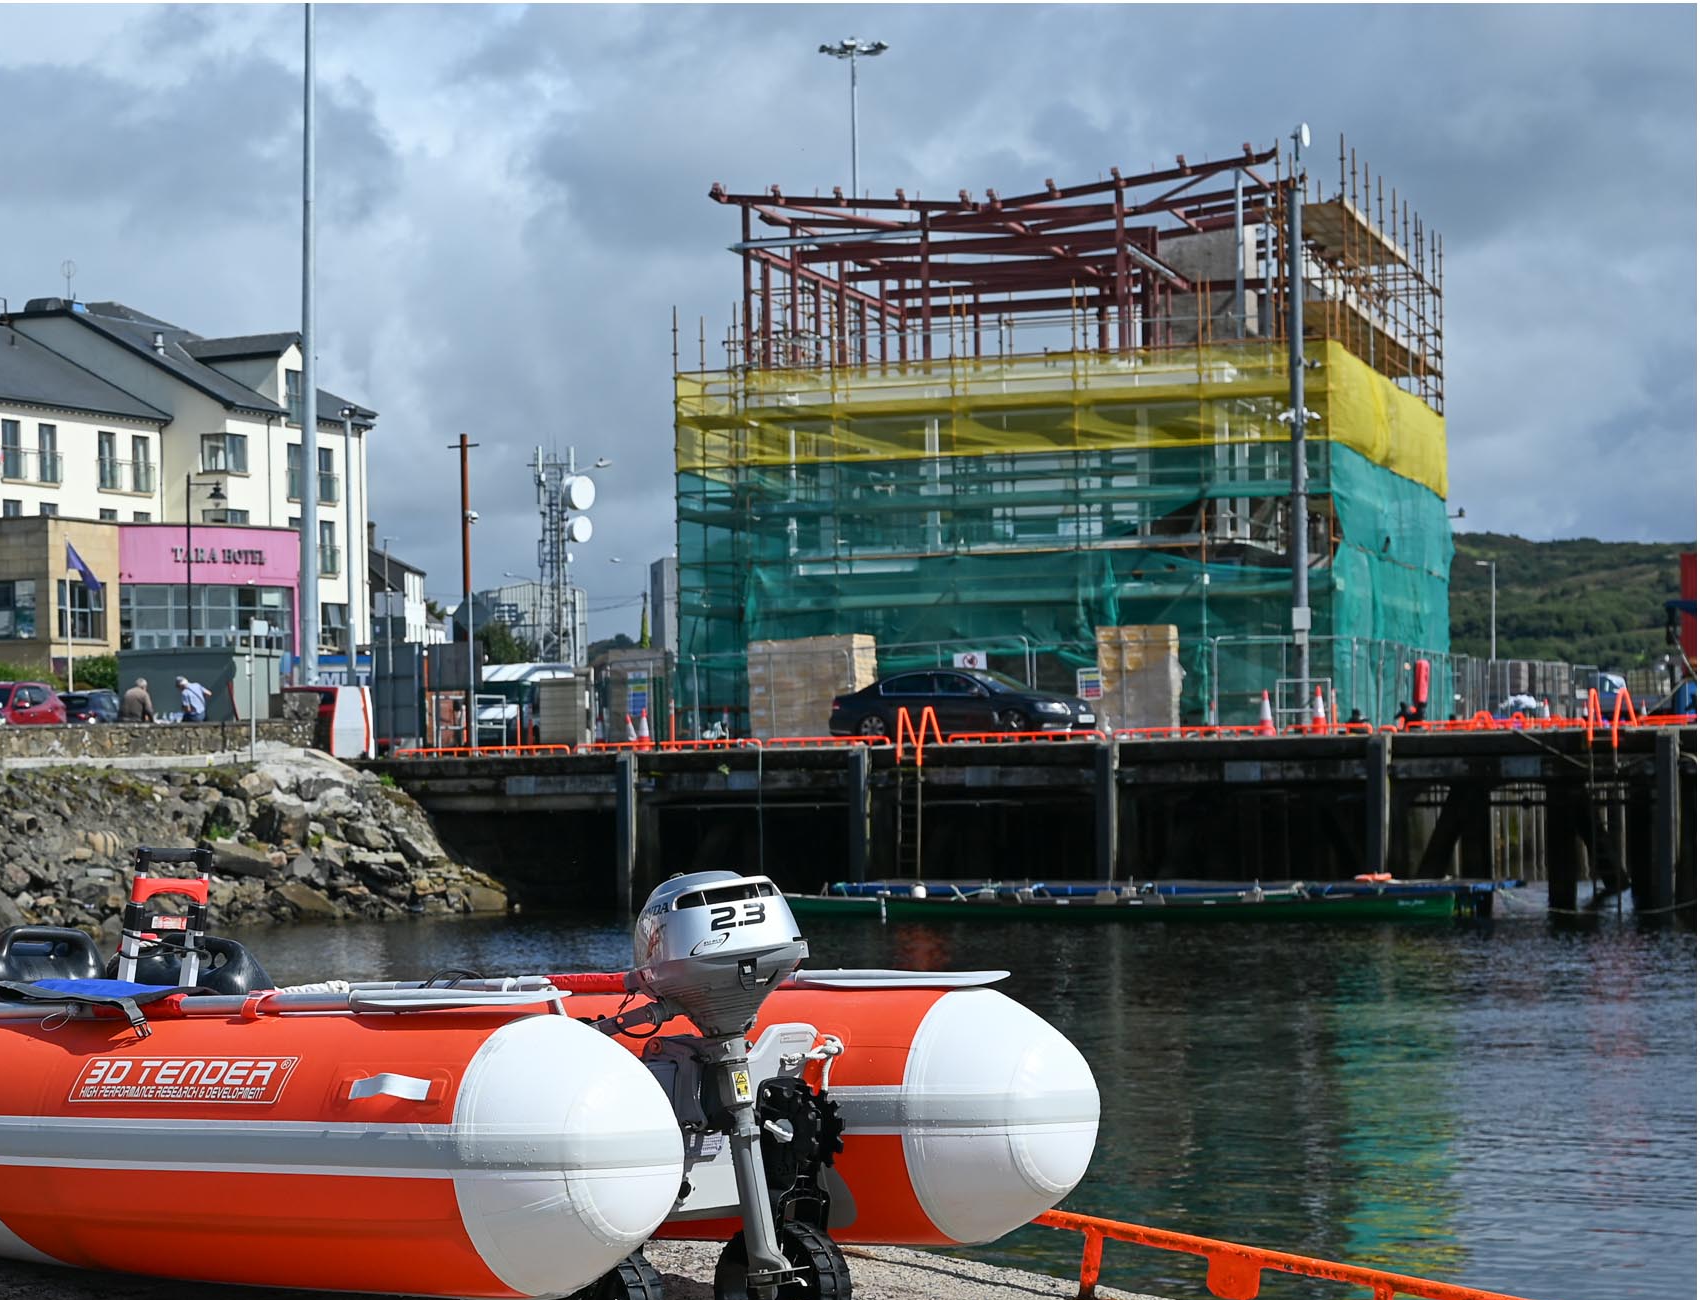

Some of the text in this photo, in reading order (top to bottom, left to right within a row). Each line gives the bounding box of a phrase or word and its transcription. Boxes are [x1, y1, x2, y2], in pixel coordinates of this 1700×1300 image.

[171, 547, 266, 565] TARA HOTEL
[711, 902, 766, 931] 2.3
[84, 1060, 278, 1086] 3D TENDER
[79, 1085, 267, 1100] HIGH PERFORMANCE RESEARCH & DEVELOPMENT
